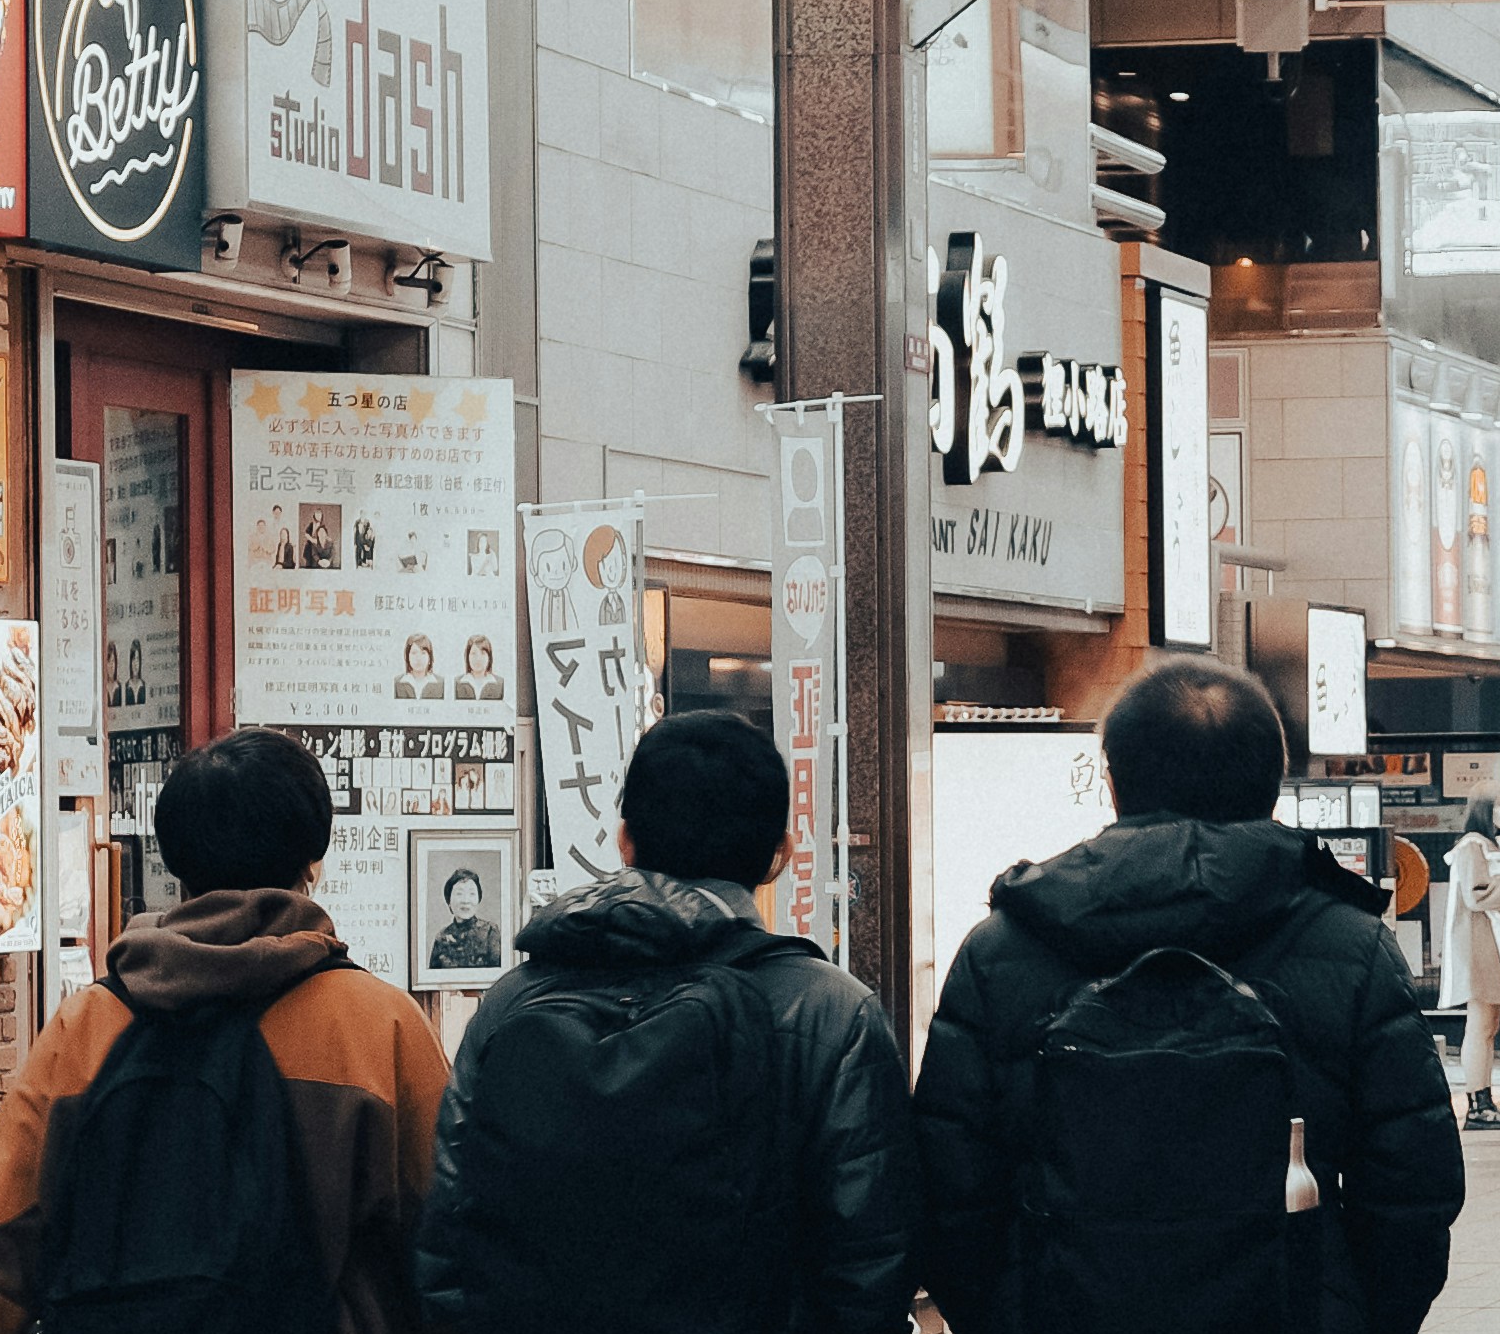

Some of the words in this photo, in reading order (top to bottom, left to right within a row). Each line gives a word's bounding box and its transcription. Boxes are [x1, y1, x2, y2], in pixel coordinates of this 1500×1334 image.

[68, 23, 198, 168] Betty
[269, 90, 340, 173] studio
[326, 392, 408, 411] 五つ星の店
[268, 418, 485, 442] 必ず気に入った写真ができます
[268, 440, 485, 465] 写真が苦手な方もおすすめのお店です
[249, 465, 356, 495] 記念写真
[967, 508, 1000, 558] SAI
[1006, 513, 1053, 567] KAKU
[248, 587, 356, 617] 証明写真
[332, 825, 399, 853] 特別企画
[339, 859, 384, 875] 半切判
